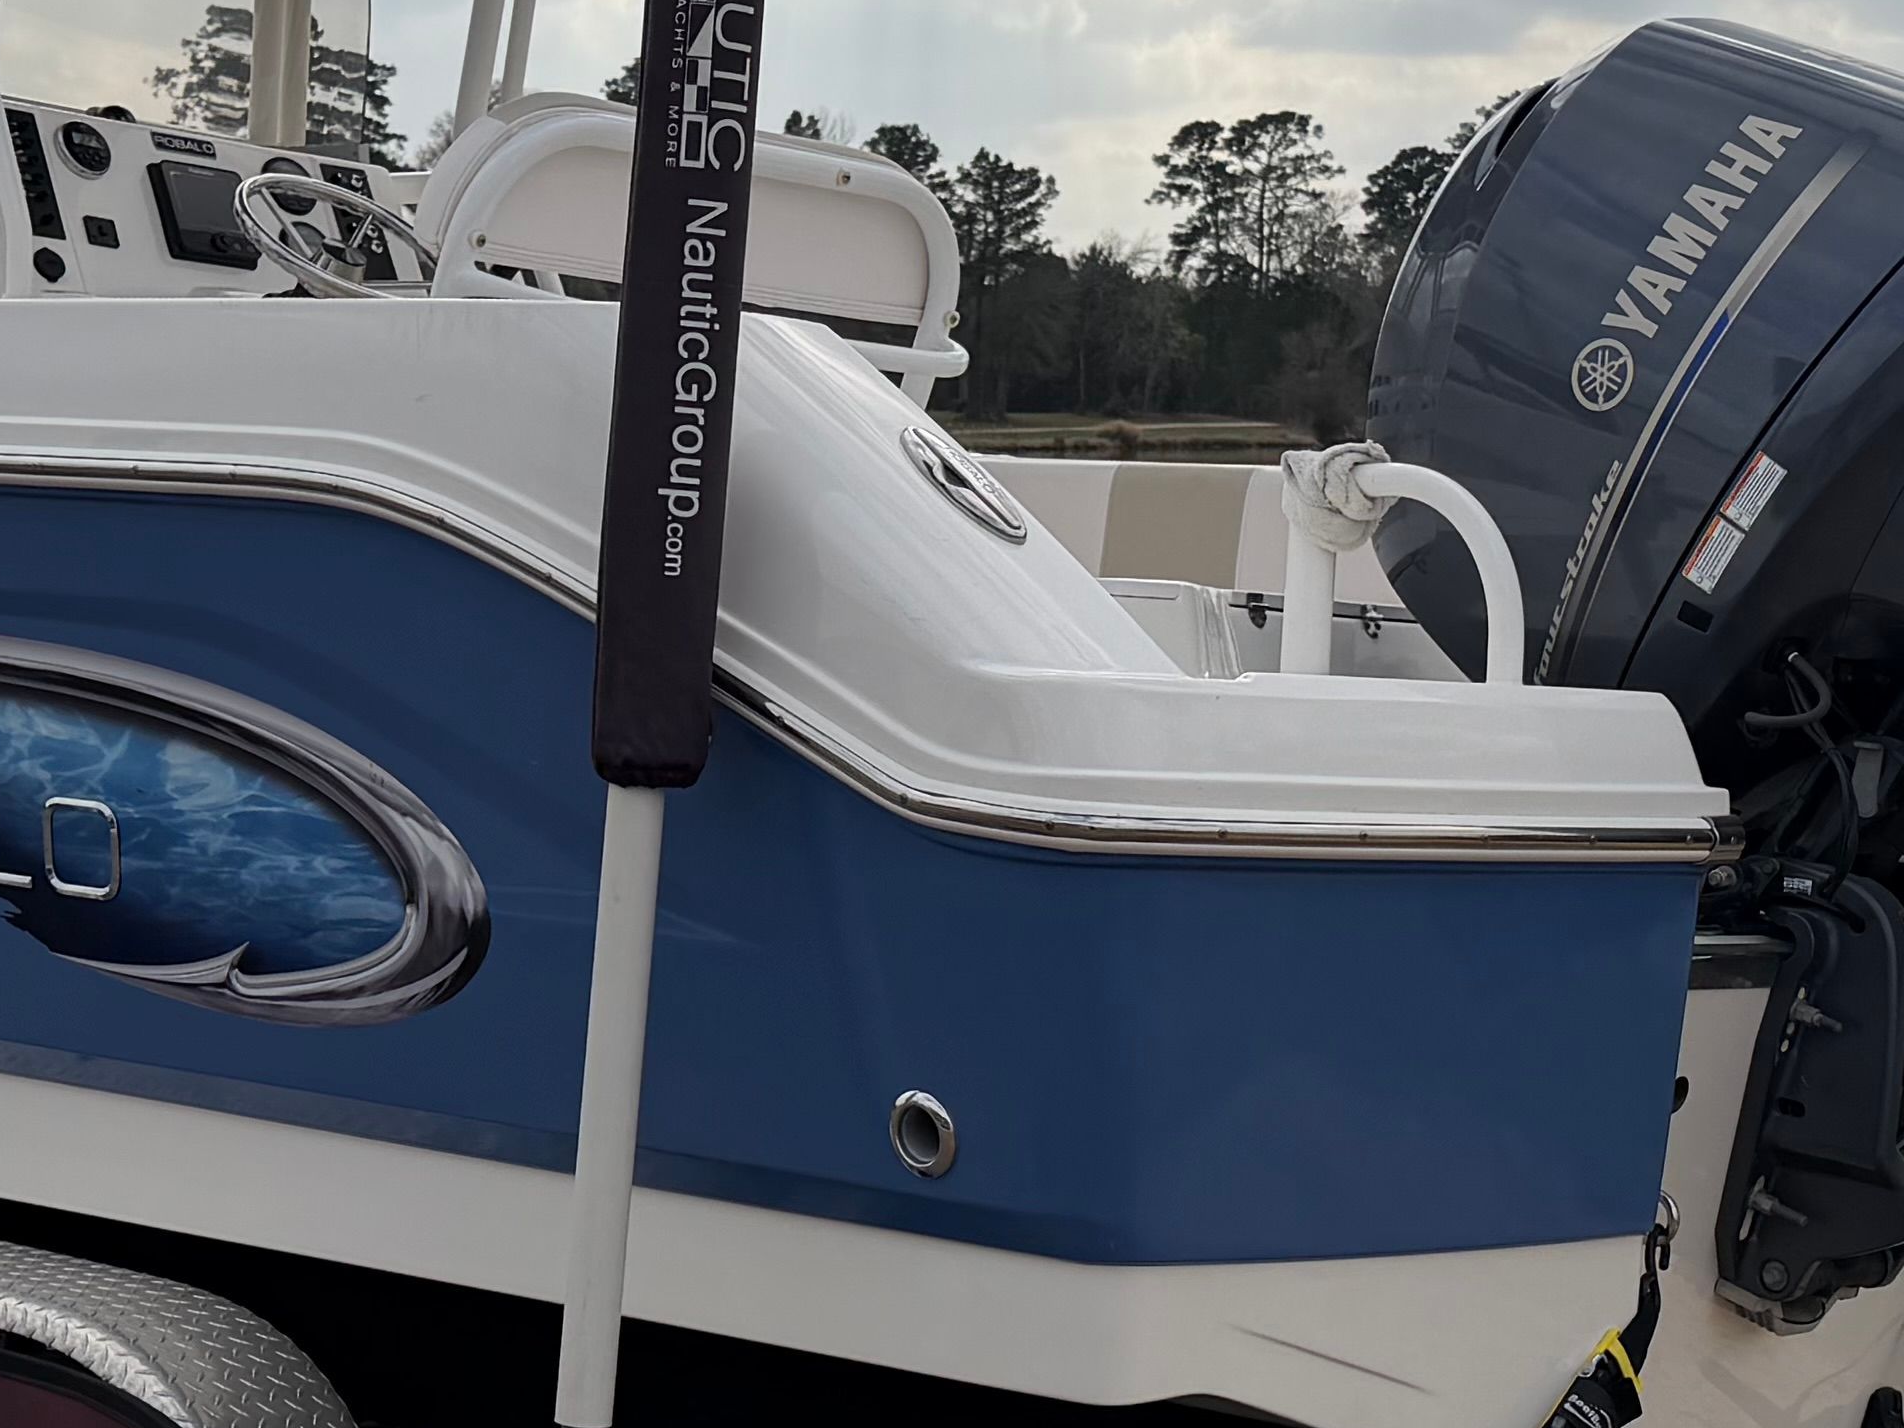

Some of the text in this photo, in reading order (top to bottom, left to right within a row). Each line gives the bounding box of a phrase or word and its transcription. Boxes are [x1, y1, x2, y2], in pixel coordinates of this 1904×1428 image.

[665, 105, 680, 168] MORE
[669, 81, 682, 93] &
[1600, 114, 1804, 340] YAMAHA
[657, 196, 729, 578] NauticGroup.com
